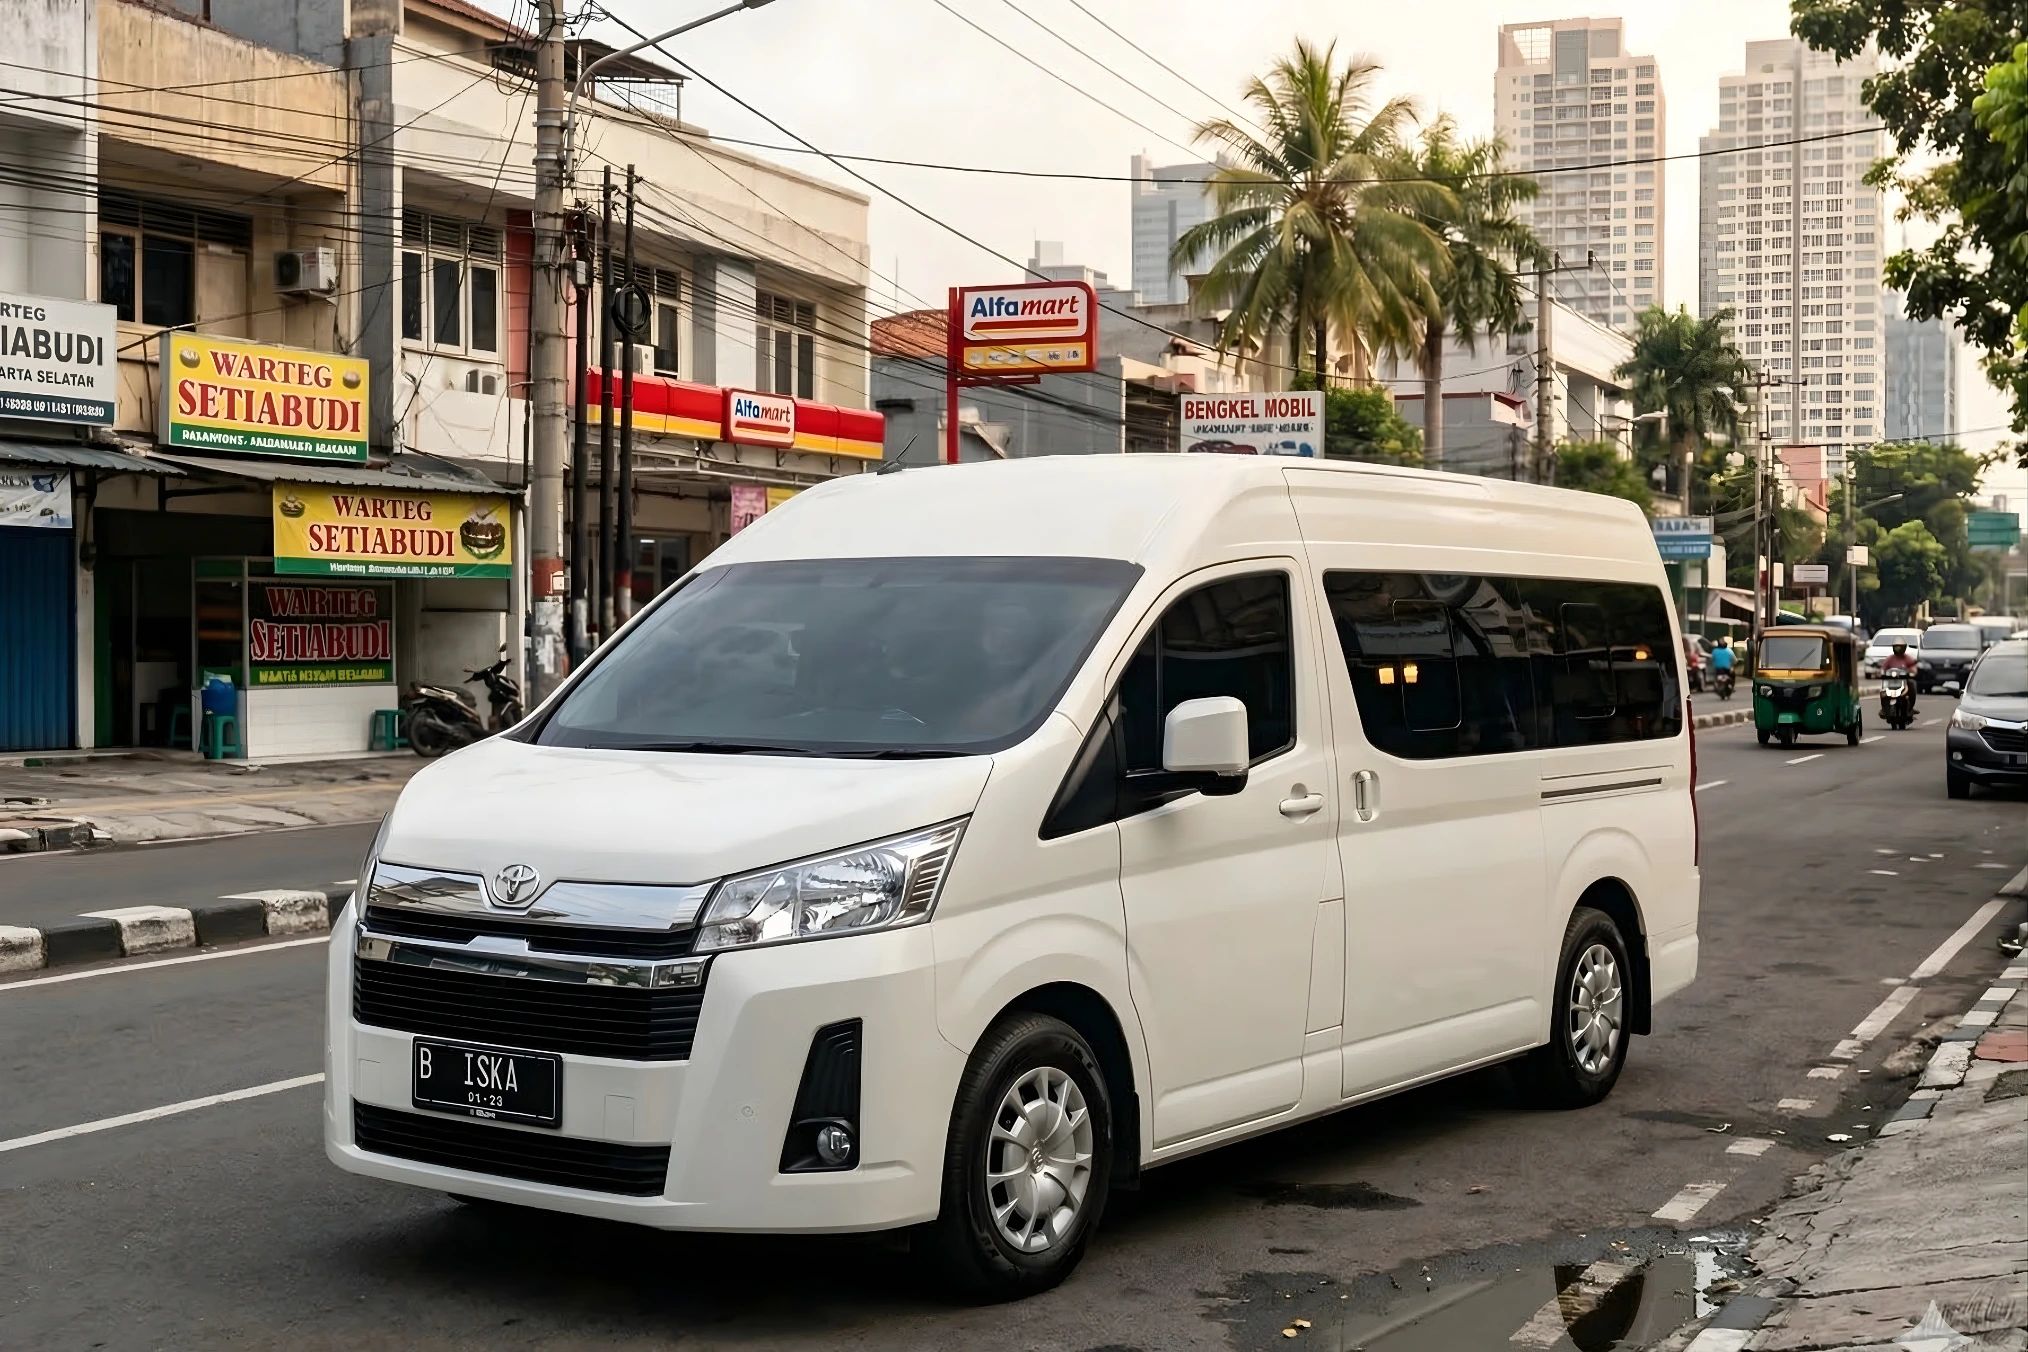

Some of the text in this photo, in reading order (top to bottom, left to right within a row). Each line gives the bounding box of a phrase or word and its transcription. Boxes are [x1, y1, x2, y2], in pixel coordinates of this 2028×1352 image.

[0, 302, 46, 322] RTEG
[971, 295, 1079, 318] Alfamart
[1, 325, 103, 367] IABUDI
[37, 370, 94, 388] SELATAN
[210, 350, 332, 389] WARTEG
[178, 379, 361, 434] SETIABUDI
[735, 398, 791, 423] Alfamart
[1184, 398, 1316, 420] BENGKEL MOBIL
[332, 495, 432, 521] WARTEG
[309, 523, 455, 557] SETIABUDI
[265, 586, 378, 617] WARTEG
[250, 618, 391, 661] SETIABUDI
[420, 1047, 518, 1092] B ISKA
